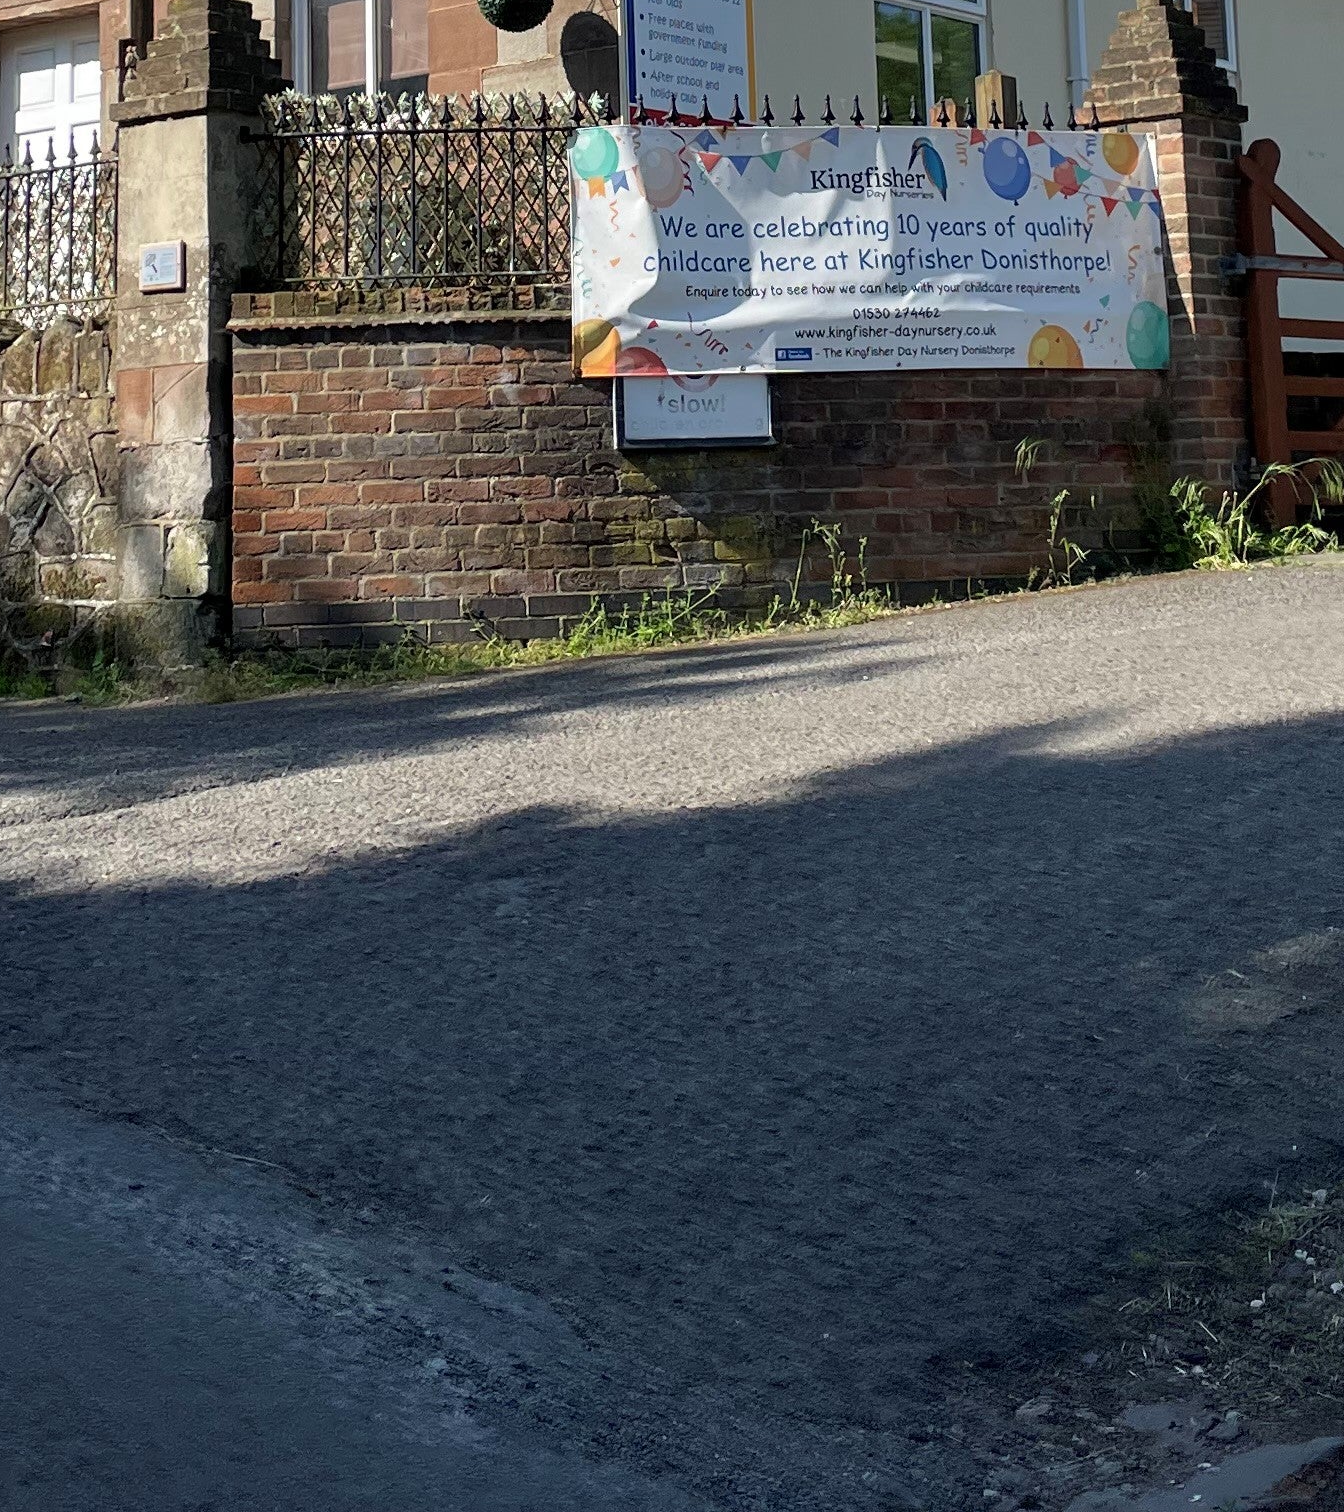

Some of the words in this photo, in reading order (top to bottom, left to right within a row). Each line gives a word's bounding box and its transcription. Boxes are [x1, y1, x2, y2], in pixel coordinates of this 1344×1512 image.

[648, 12, 667, 25] Free
[669, 17, 694, 31] places
[696, 22, 715, 35] with
[648, 29, 696, 47] government
[697, 38, 727, 54] funding
[648, 48, 673, 63] Large
[674, 55, 708, 69] outdoor
[710, 61, 725, 73] play
[727, 64, 744, 76] area
[649, 69, 674, 83] After
[676, 75, 703, 88] school
[705, 80, 720, 91] and
[680, 92, 698, 104] club
[810, 167, 926, 193] Kingfisher
[866, 189, 886, 202] Day
[890, 188, 934, 199] Nurseries
[660, 215, 698, 238] We
[705, 222, 744, 238] are
[753, 215, 889, 242] celebrating
[896, 214, 920, 235] 10
[926, 221, 987, 242] years
[994, 215, 1016, 238] of
[1025, 215, 1094, 243] quality
[643, 249, 752, 272] childcare
[760, 250, 817, 272] here
[824, 250, 849, 272] at
[859, 247, 973, 276] Kingfisher
[981, 248, 1112, 277] Donisthorpe!
[685, 285, 729, 300] Enquire
[732, 285, 767, 299] today
[771, 284, 783, 296] to
[786, 286, 808, 295] see
[811, 283, 835, 295] how
[839, 284, 856, 294] we
[859, 283, 882, 294] can
[884, 282, 907, 296] help
[911, 282, 934, 293] with
[937, 283, 960, 296] your
[964, 282, 1013, 294] childcare
[1016, 283, 1081, 296] requirements
[853, 307, 890, 320] 01530
[895, 307, 942, 320] 274462
[795, 323, 997, 341] www.kingfisher-daynursery.co.uk
[823, 347, 843, 357] The
[845, 346, 894, 360] Kingfisher
[897, 346, 918, 359] Day
[920, 345, 958, 358] Nursery
[962, 345, 1016, 357] Donisthorpe
[668, 394, 727, 413] slow!
